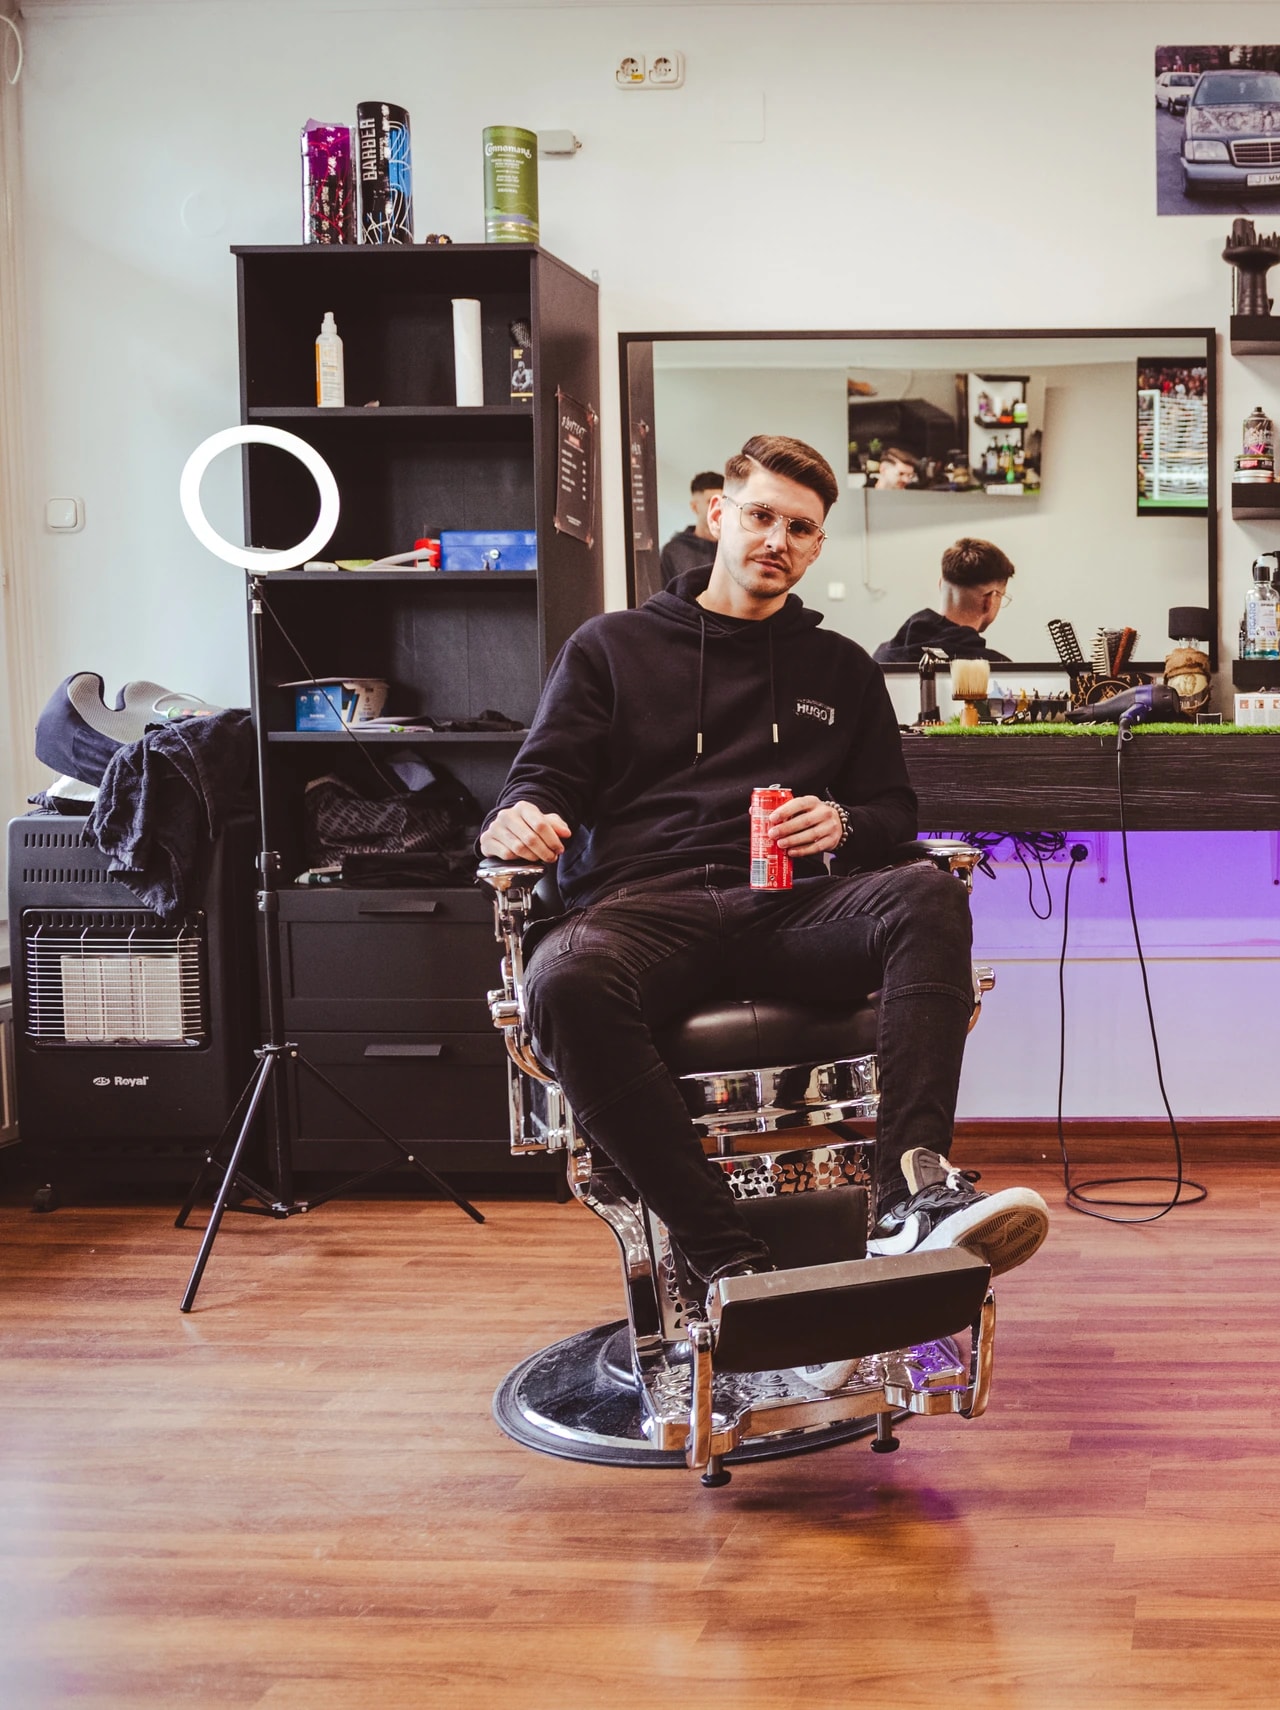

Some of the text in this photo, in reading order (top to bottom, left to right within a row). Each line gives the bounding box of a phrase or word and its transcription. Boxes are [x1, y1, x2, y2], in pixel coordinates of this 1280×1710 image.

[360, 118, 377, 181] BARBER
[1249, 602, 1257, 637] FIGARO
[796, 702, 828, 721] HUGO
[114, 1076, 147, 1087] Royal
